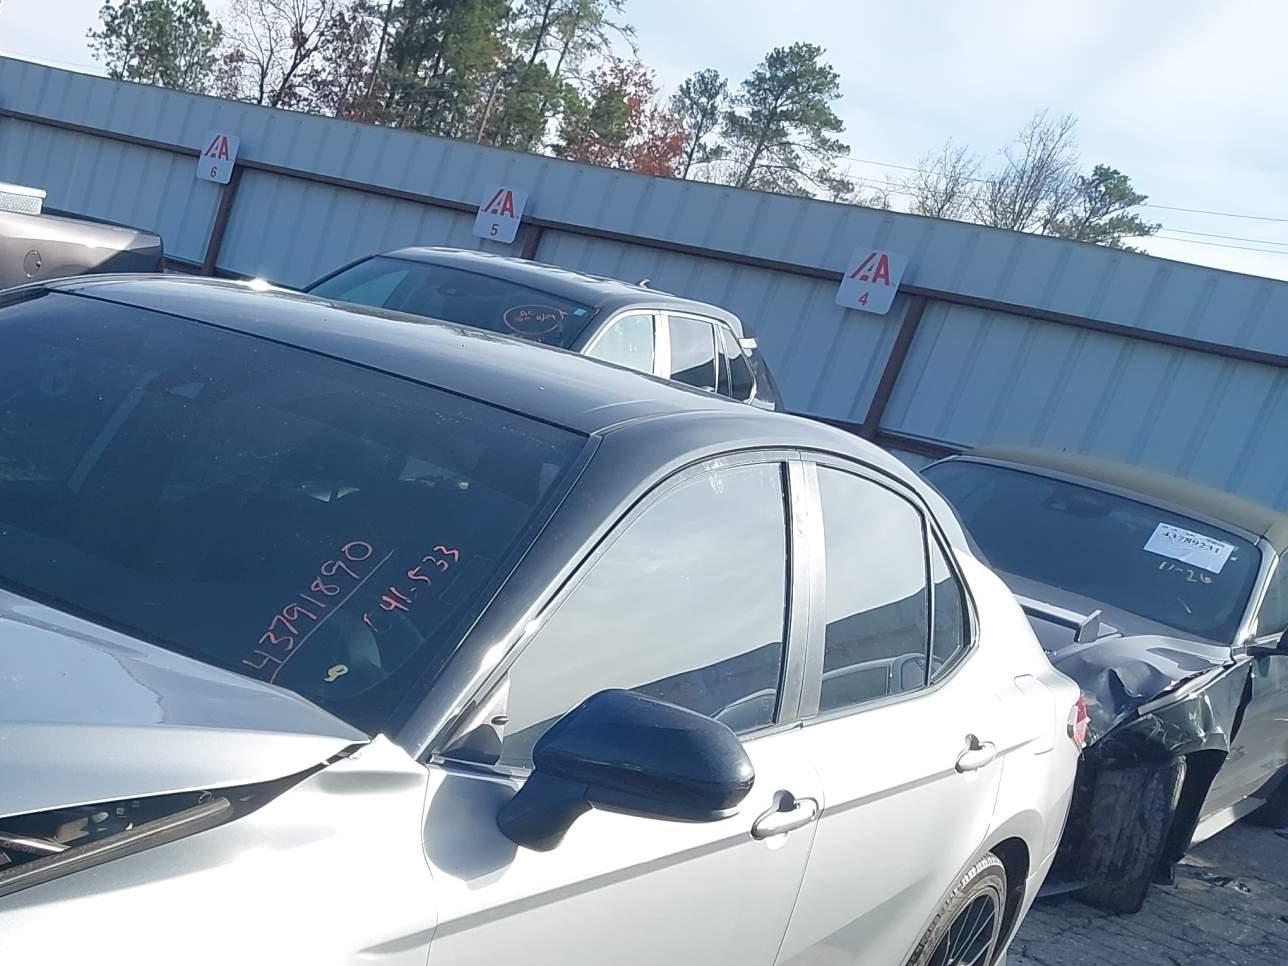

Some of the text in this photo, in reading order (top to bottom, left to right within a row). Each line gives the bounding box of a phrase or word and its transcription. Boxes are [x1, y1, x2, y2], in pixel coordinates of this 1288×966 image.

[210, 166, 218, 178] 6
[490, 223, 500, 236] 5
[858, 292, 869, 306] 4
[242, 541, 372, 670] 43791890
